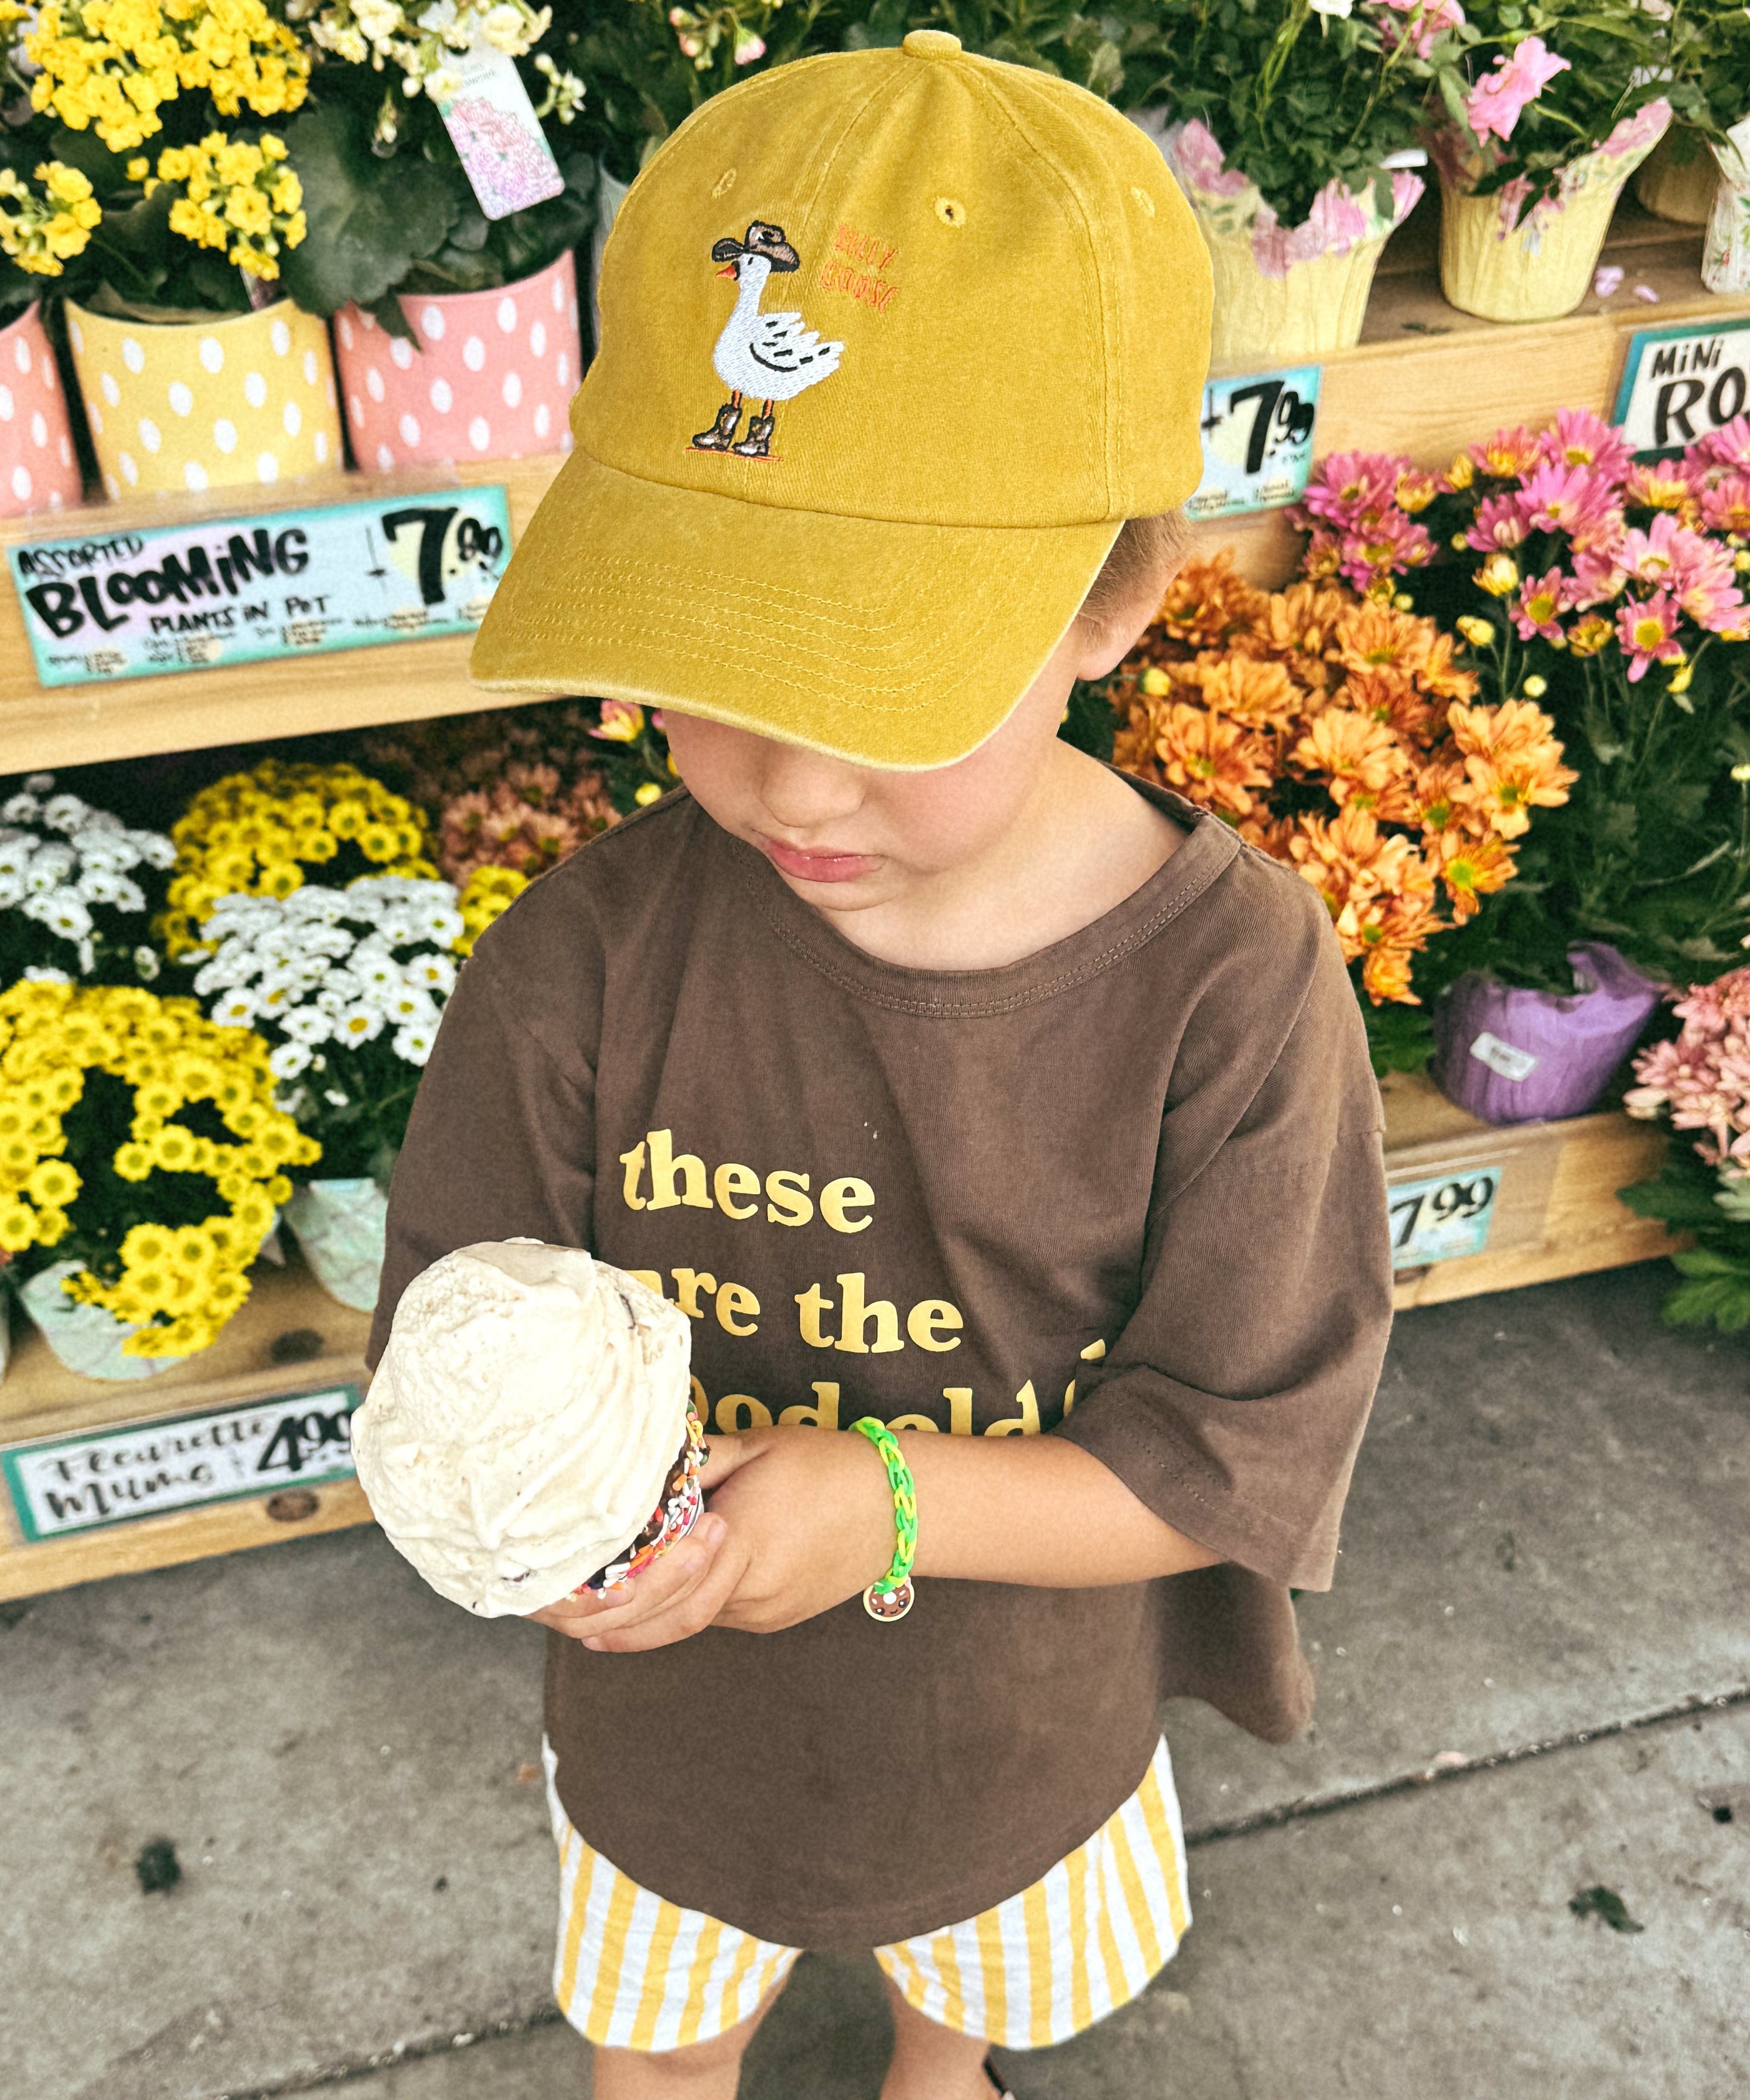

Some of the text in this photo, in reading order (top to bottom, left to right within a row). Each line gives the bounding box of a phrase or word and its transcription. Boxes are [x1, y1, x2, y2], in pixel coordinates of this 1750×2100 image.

[1655, 367, 1750, 448] RO
[620, 1129, 875, 1233] these
[794, 1272, 963, 1354] the
